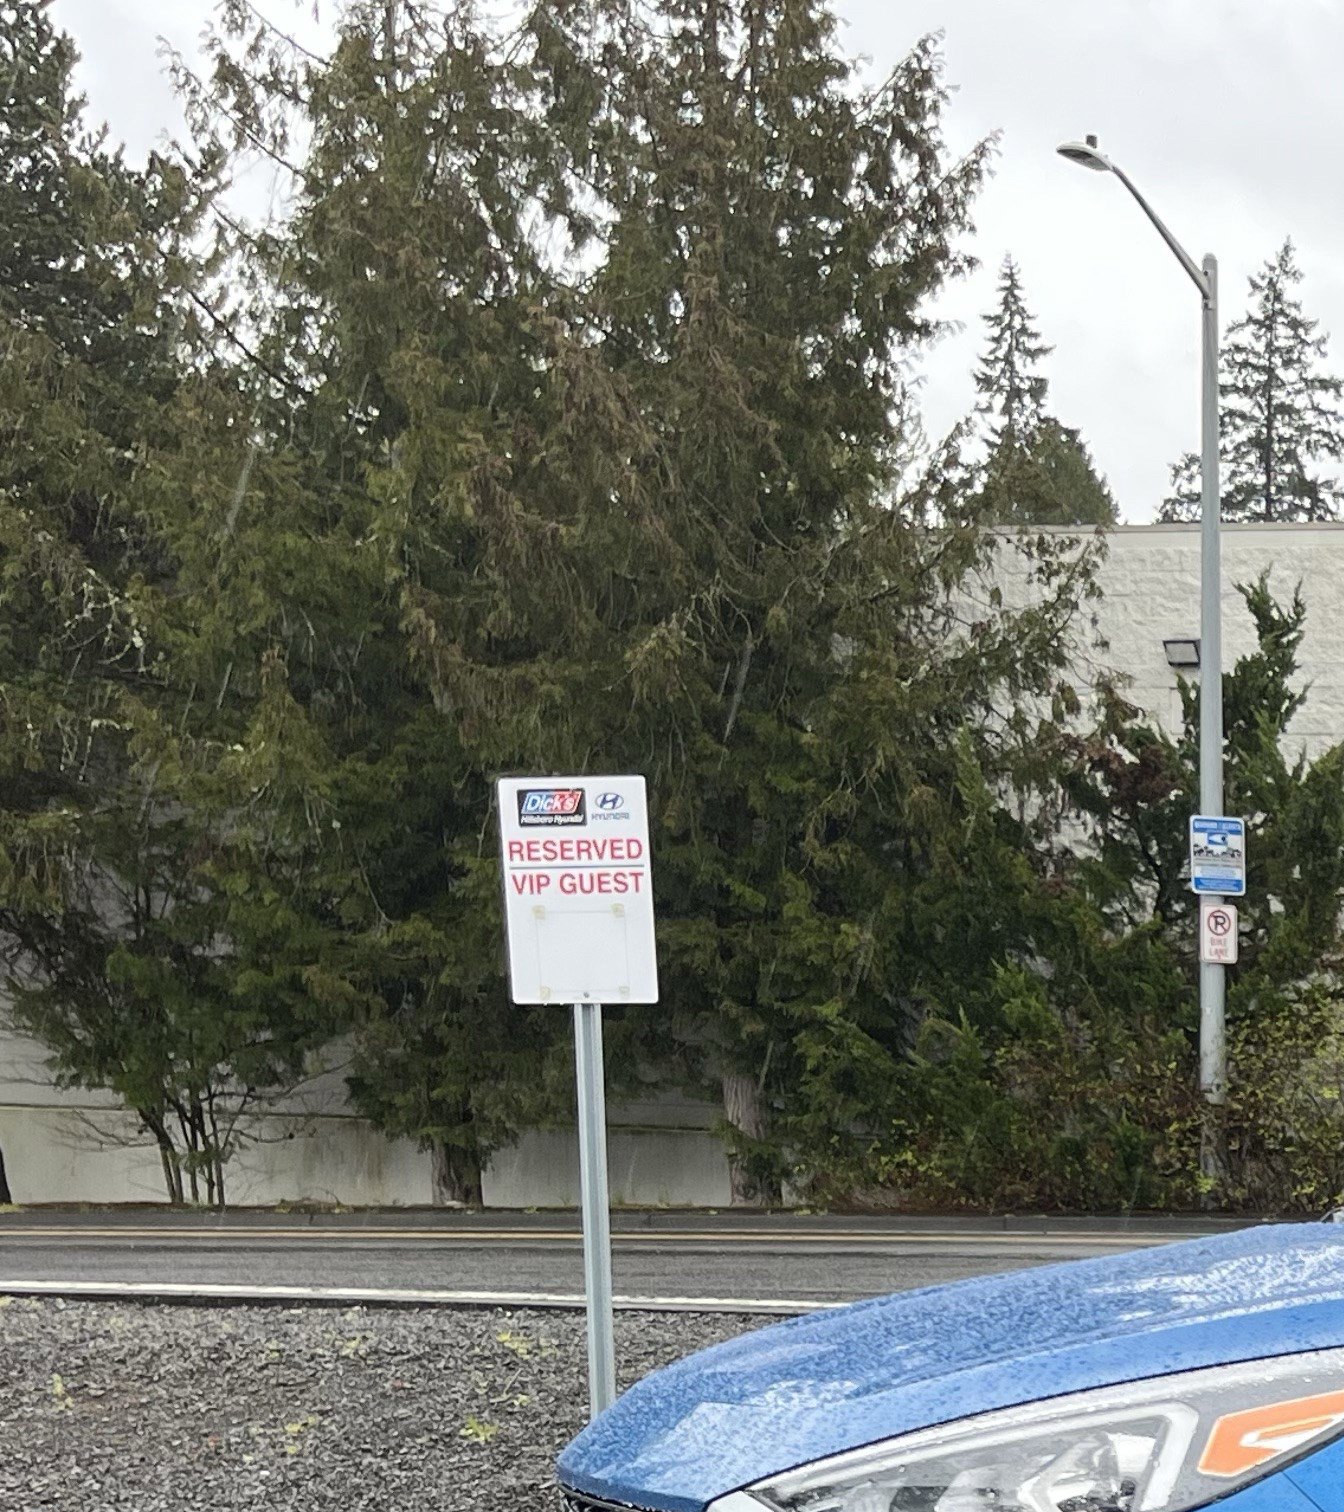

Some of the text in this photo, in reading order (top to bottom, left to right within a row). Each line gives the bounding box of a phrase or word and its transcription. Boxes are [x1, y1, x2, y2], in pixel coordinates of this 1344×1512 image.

[508, 839, 643, 862] RESERVED
[512, 873, 644, 895] VIP GUEST
